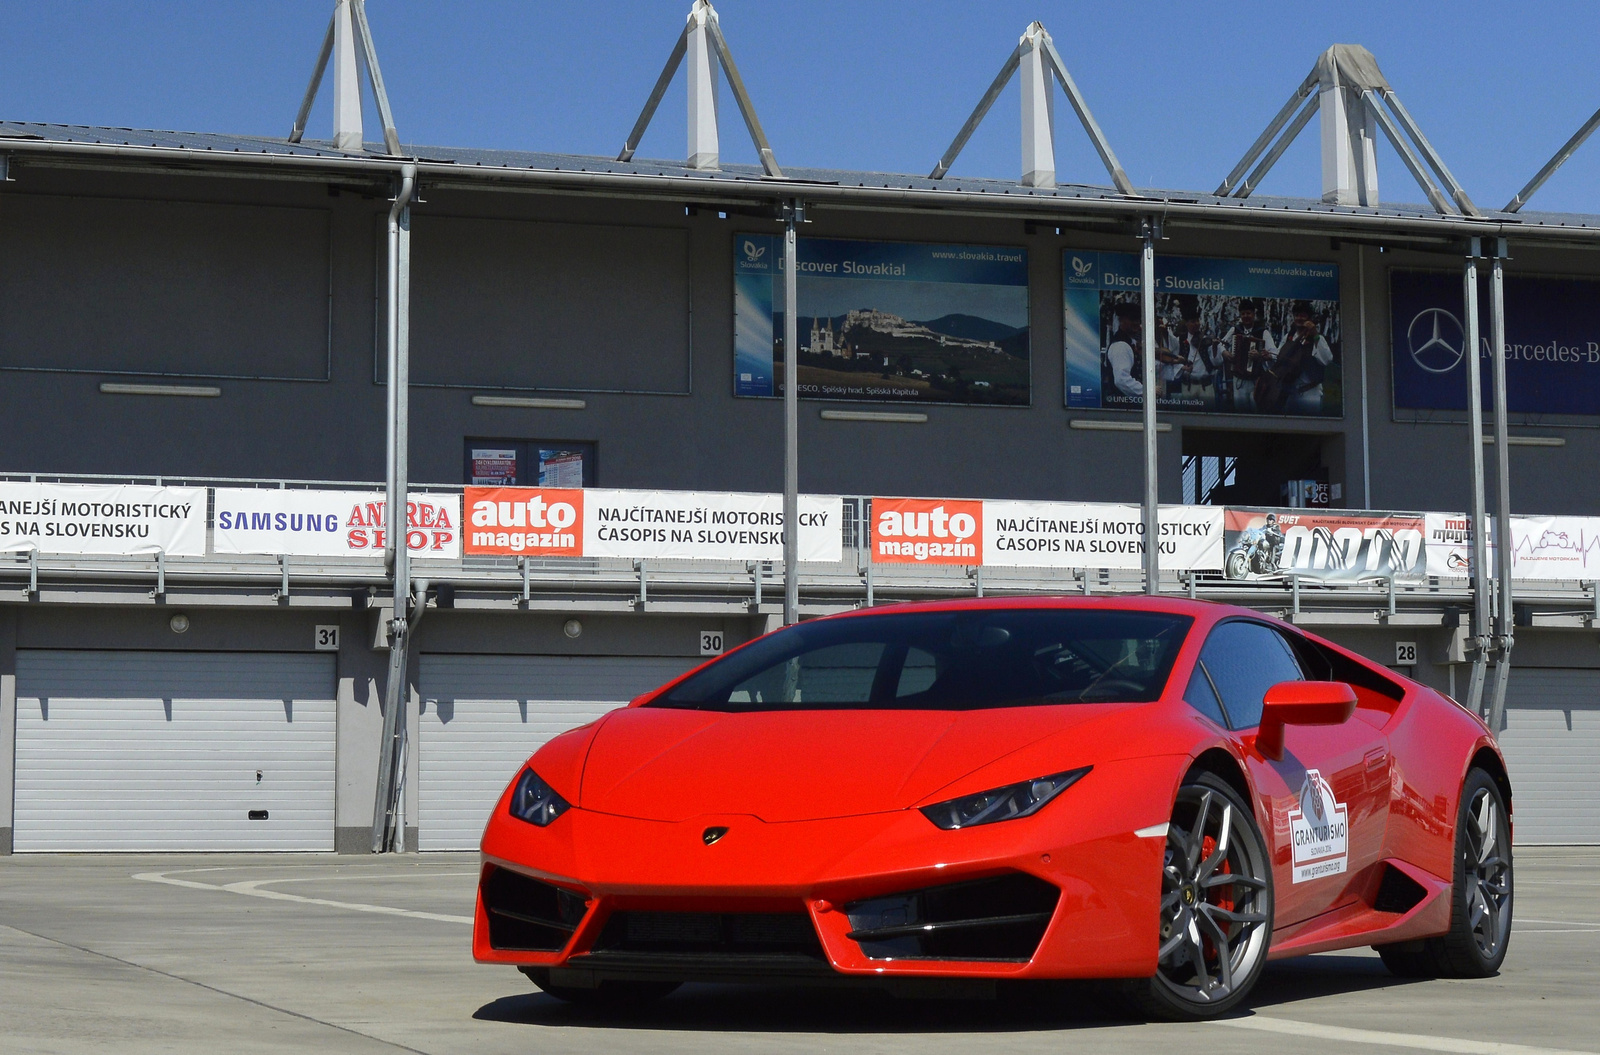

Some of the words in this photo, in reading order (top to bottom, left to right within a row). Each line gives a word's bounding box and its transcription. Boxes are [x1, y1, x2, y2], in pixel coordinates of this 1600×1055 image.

[740, 261, 768, 269] Slovakia
[932, 250, 1022, 263] www.slovakia.travel
[843, 260, 906, 276] Slovakia!
[1248, 266, 1333, 278] www.slovakia.travel
[1068, 276, 1095, 285] Slovakia
[1165, 276, 1225, 291] Slovakia!
[822, 385, 847, 395] Spišský
[892, 388, 919, 396] Kapitula
[61, 502, 191, 519] MOTORISTICKÝ
[346, 501, 454, 529] ANREA
[471, 495, 576, 528] auto
[598, 506, 708, 524] NAJČÍTANEJŠÍ
[712, 510, 828, 527] MOTORISCKÝ
[219, 511, 338, 532] SAMSUNG
[878, 506, 976, 538] auto
[996, 516, 1099, 534] NAJČÍTANEJŠÍ
[1102, 520, 1211, 536] MOTOISTICKÝ
[1278, 515, 1300, 525] SVET
[1445, 519, 1472, 530] mot
[15, 521, 40, 536] NA
[45, 522, 149, 538] SLOVENSKU
[597, 525, 666, 542] ČASOPIS
[671, 529, 694, 543] NA
[472, 527, 575, 551] magazín
[996, 535, 1060, 552] ČASOPIS
[1064, 540, 1086, 553] NA
[1090, 540, 1176, 554] SLOVENKU
[879, 536, 976, 560] magazín
[1279, 526, 1422, 571] MOTO
[318, 629, 337, 646] 31
[702, 635, 722, 650] 30
[1398, 645, 1415, 660] 28
[1295, 822, 1345, 846] GRANTURISMO
